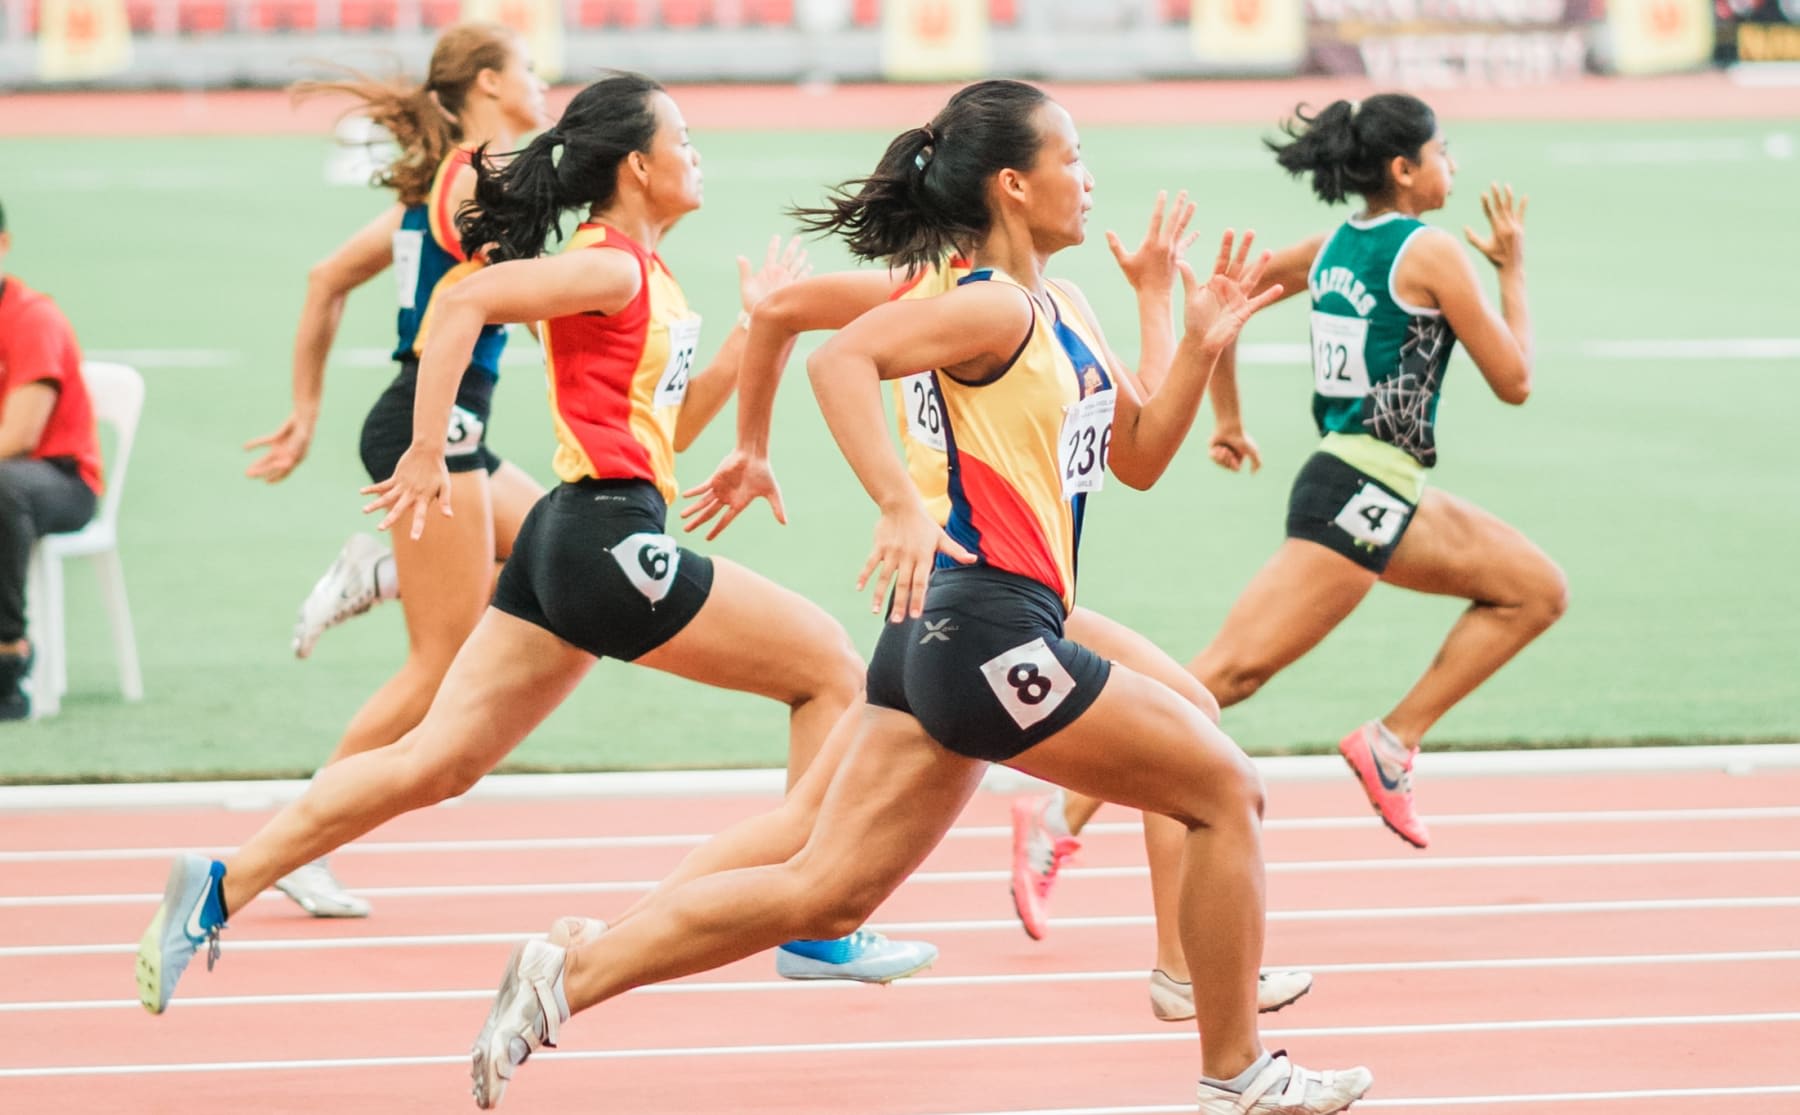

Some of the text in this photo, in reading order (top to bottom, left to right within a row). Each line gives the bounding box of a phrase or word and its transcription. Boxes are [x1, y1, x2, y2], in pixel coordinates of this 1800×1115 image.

[913, 380, 940, 434] 26
[1359, 505, 1388, 532] 4
[638, 543, 670, 581] 6
[1007, 662, 1052, 705] 8
